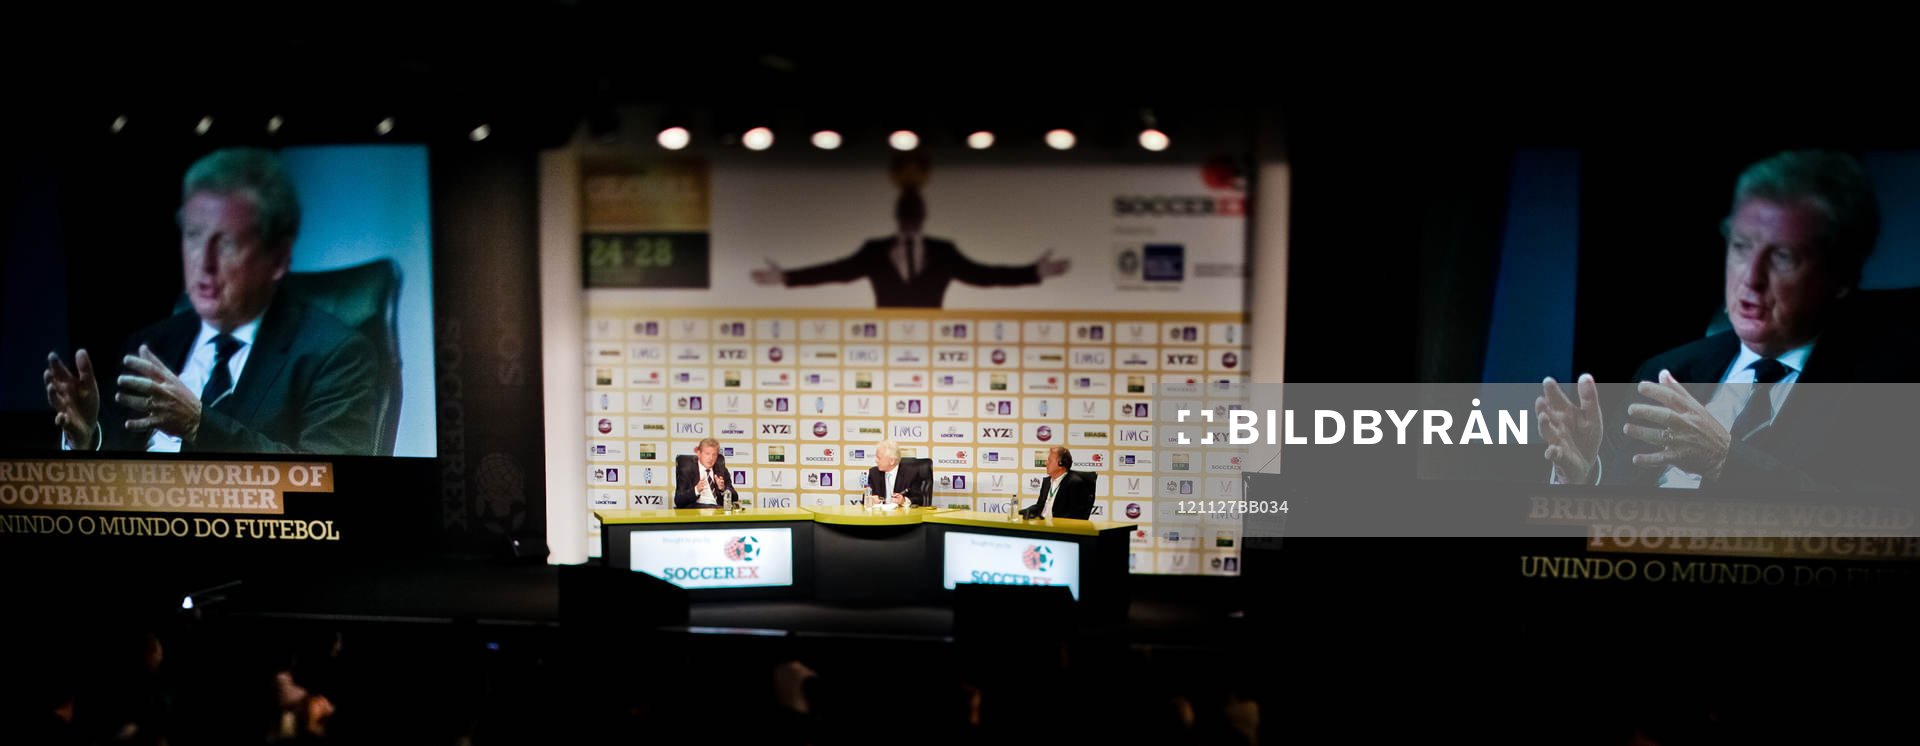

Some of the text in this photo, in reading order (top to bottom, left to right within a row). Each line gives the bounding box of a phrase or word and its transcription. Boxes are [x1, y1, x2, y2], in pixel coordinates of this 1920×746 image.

[676, 422, 704, 434] IMG
[762, 424, 788, 434] XYZ
[894, 425, 922, 437] IMG
[983, 428, 1009, 438] XYZ
[1120, 429, 1149, 442] IMG
[123, 463, 175, 484] THE
[179, 464, 281, 486] WORLD
[287, 466, 327, 487] OF
[128, 486, 278, 509] TOGETHER
[634, 495, 659, 505] XYZ
[763, 497, 790, 508] IMG
[1529, 497, 1705, 523] BRINGING
[78, 515, 96, 536] O
[99, 516, 188, 537] MUNDO
[194, 518, 230, 538] DO
[234, 518, 340, 540] FUTEBOL
[1590, 524, 1774, 553] FOOTBALL
[663, 566, 760, 581] SOCCEREX
[1521, 556, 1637, 580] UNINDO
[1643, 560, 1666, 581] O
[1671, 561, 1785, 585] MUNDO
